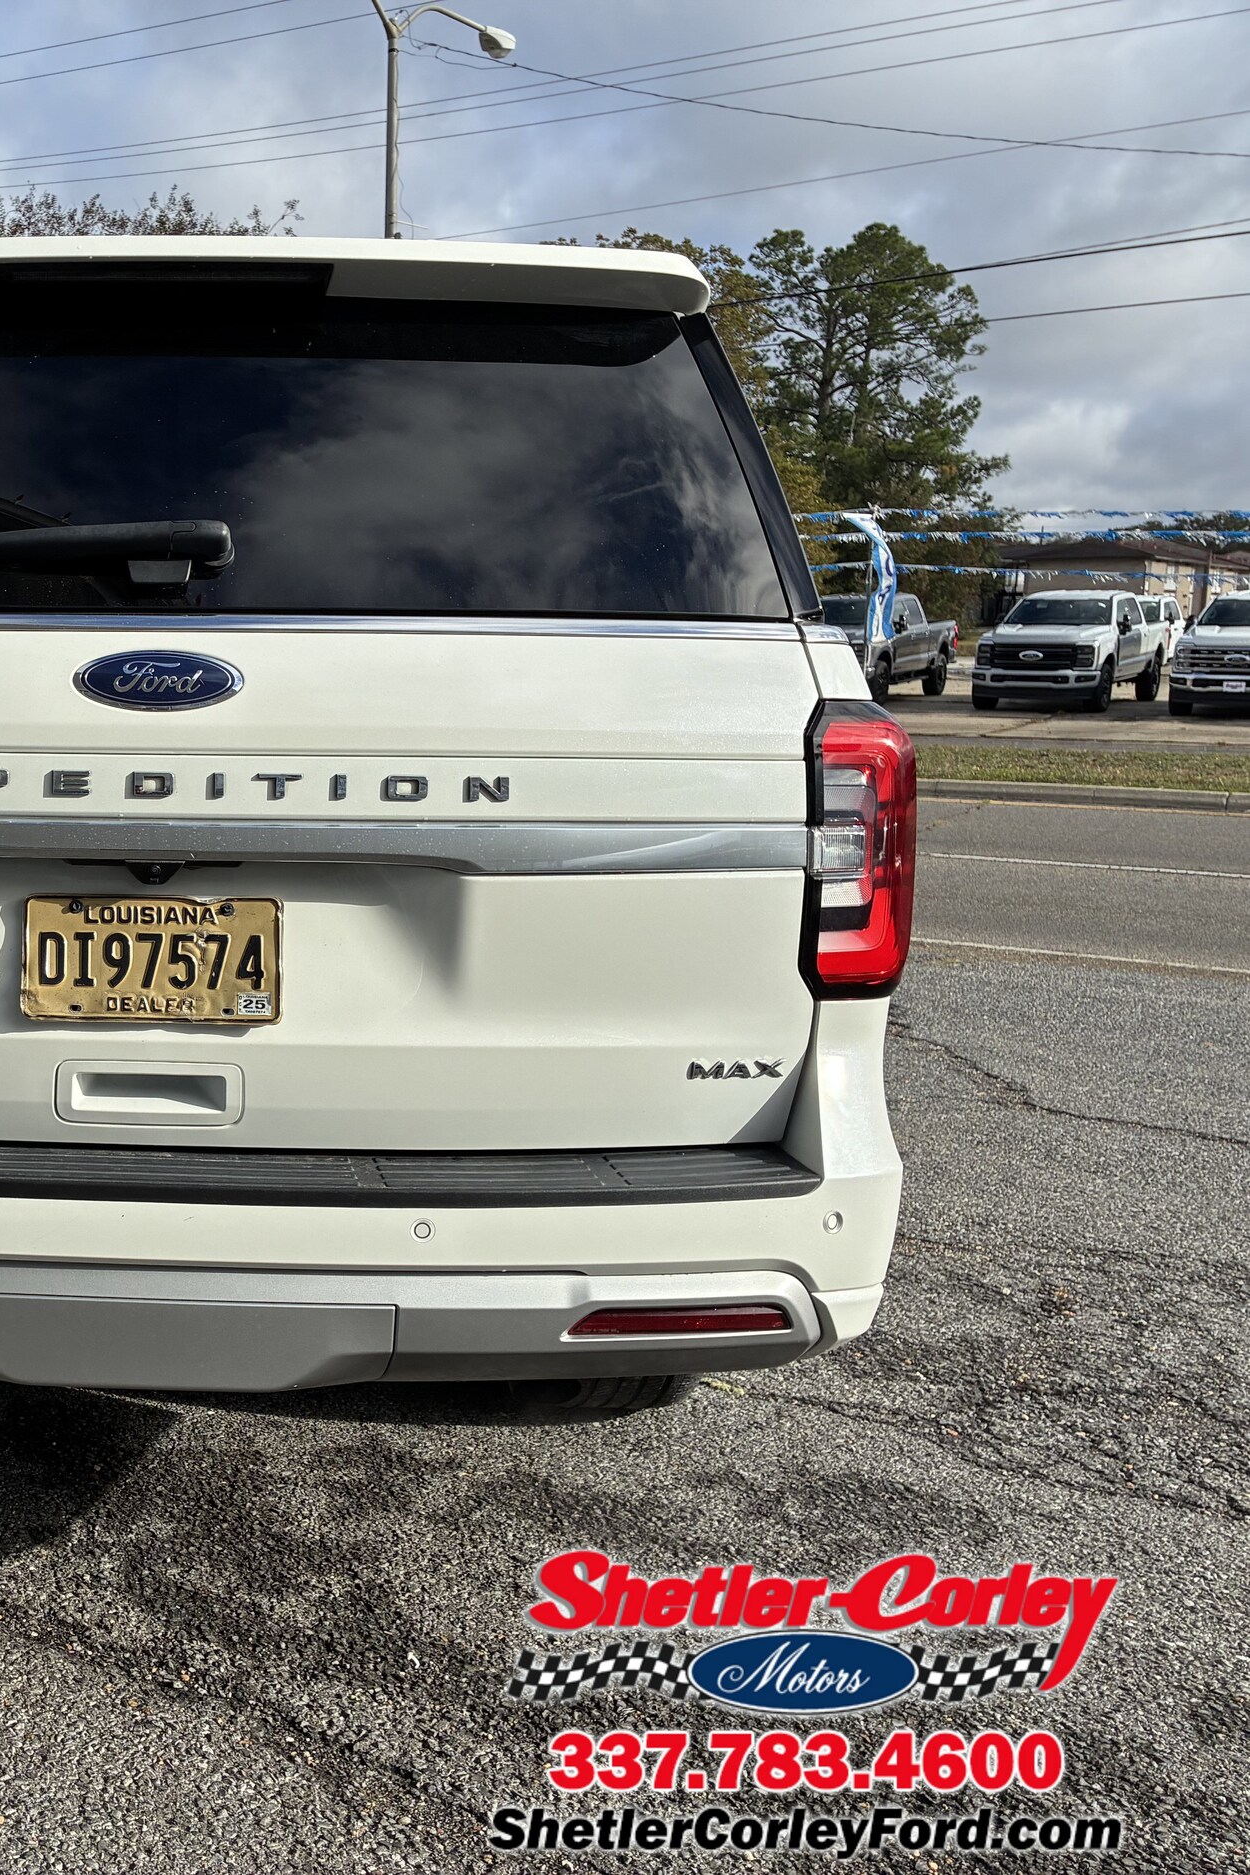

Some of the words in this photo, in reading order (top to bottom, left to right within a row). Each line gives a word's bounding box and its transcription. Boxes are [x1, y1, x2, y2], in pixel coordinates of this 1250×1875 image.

[113, 660, 205, 694] Ford
[83, 905, 219, 925] LOUISIANA
[38, 931, 266, 990] DI97574
[106, 995, 197, 1014] DEALER
[242, 998, 266, 1010] 25
[685, 1057, 787, 1080] MAX
